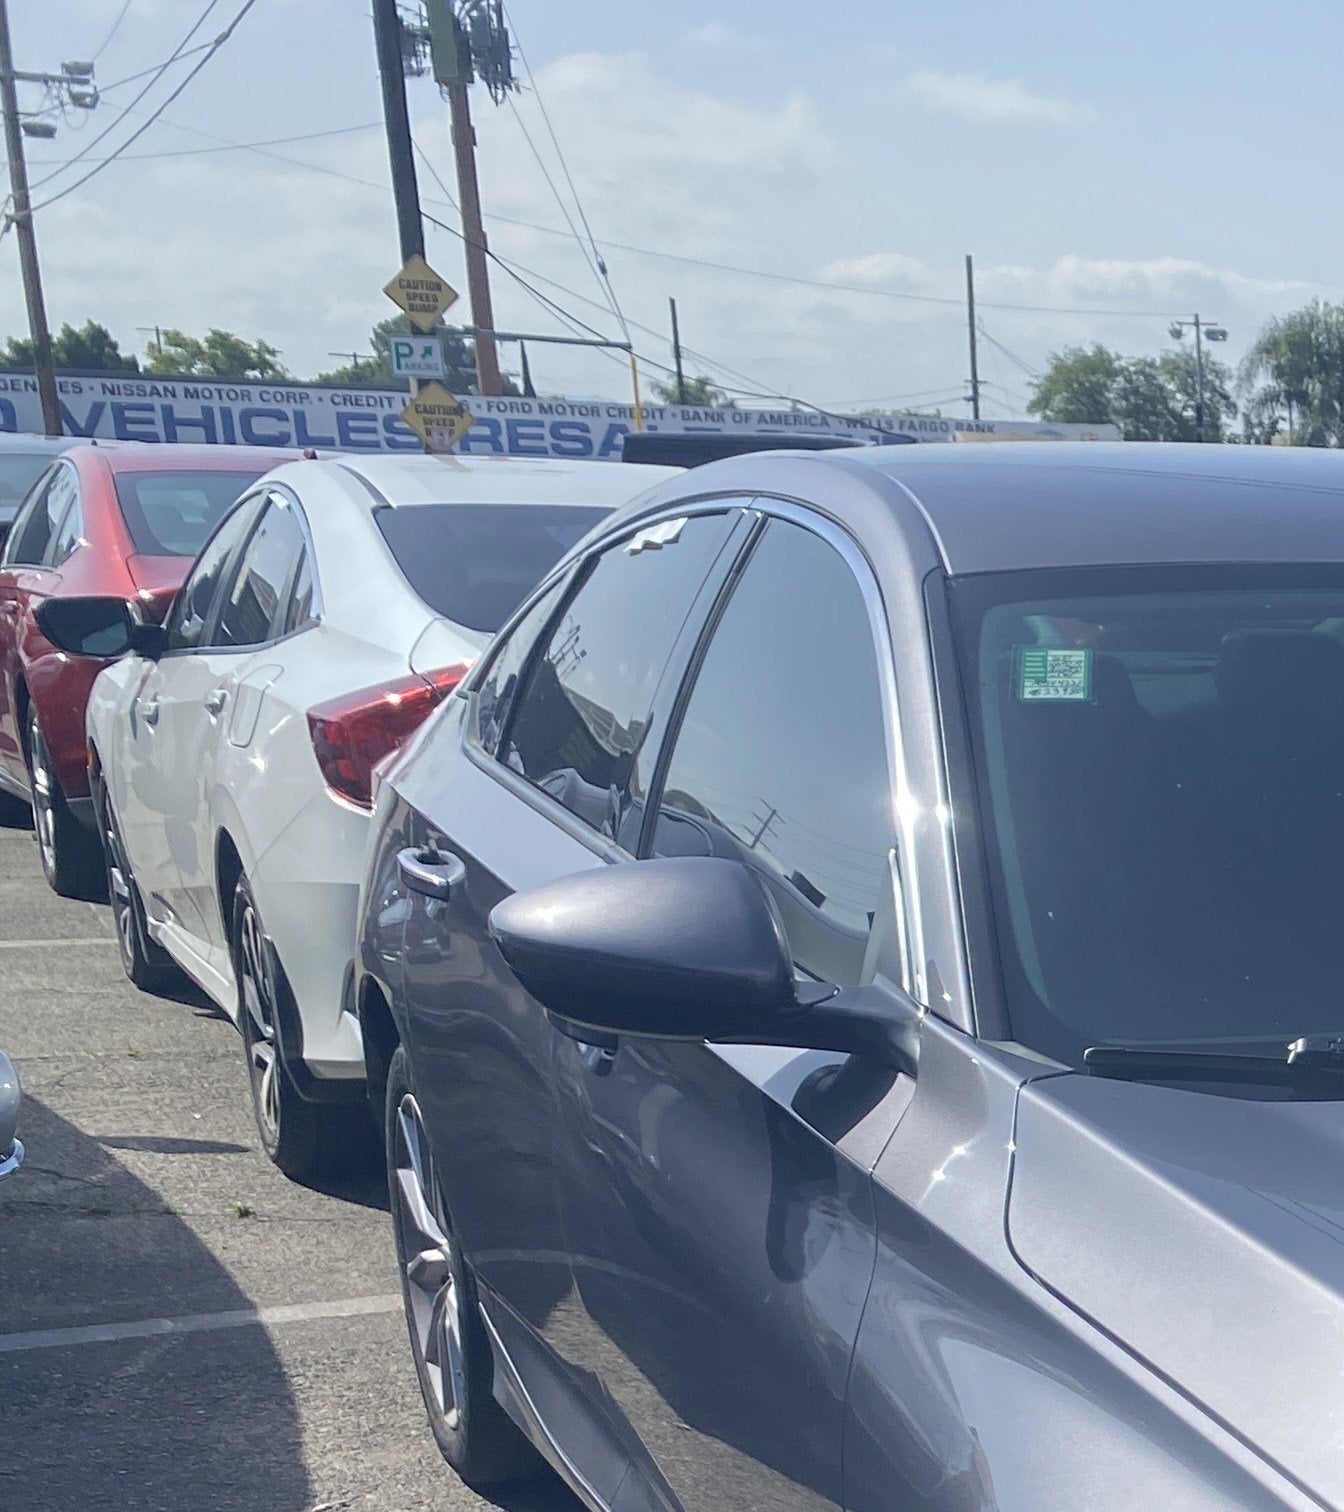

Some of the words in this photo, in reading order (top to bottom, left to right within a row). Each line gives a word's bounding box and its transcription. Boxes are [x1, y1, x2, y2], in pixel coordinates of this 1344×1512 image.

[398, 279, 442, 291] CAUTION
[406, 292, 439, 303] SPEED
[408, 303, 438, 313] BUMP
[0, 379, 83, 394] GENES
[101, 382, 176, 398] NISSAN
[184, 387, 250, 402] MOTOR
[259, 390, 313, 404] CORP.
[330, 393, 393, 408] CREDIT
[423, 417, 455, 427] SPEED
[487, 402, 532, 415] FORD
[539, 404, 600, 418] MOTOR
[606, 406, 666, 421] CREDIT
[681, 409, 725, 424] BANK
[732, 412, 752, 425] OF
[757, 413, 830, 428] AMERICA
[846, 417, 894, 431] WELLS
[899, 419, 950, 433] FARGO
[955, 421, 995, 433] BANK
[58, 398, 424, 450] VEHICLES
[425, 427, 455, 437] BP
